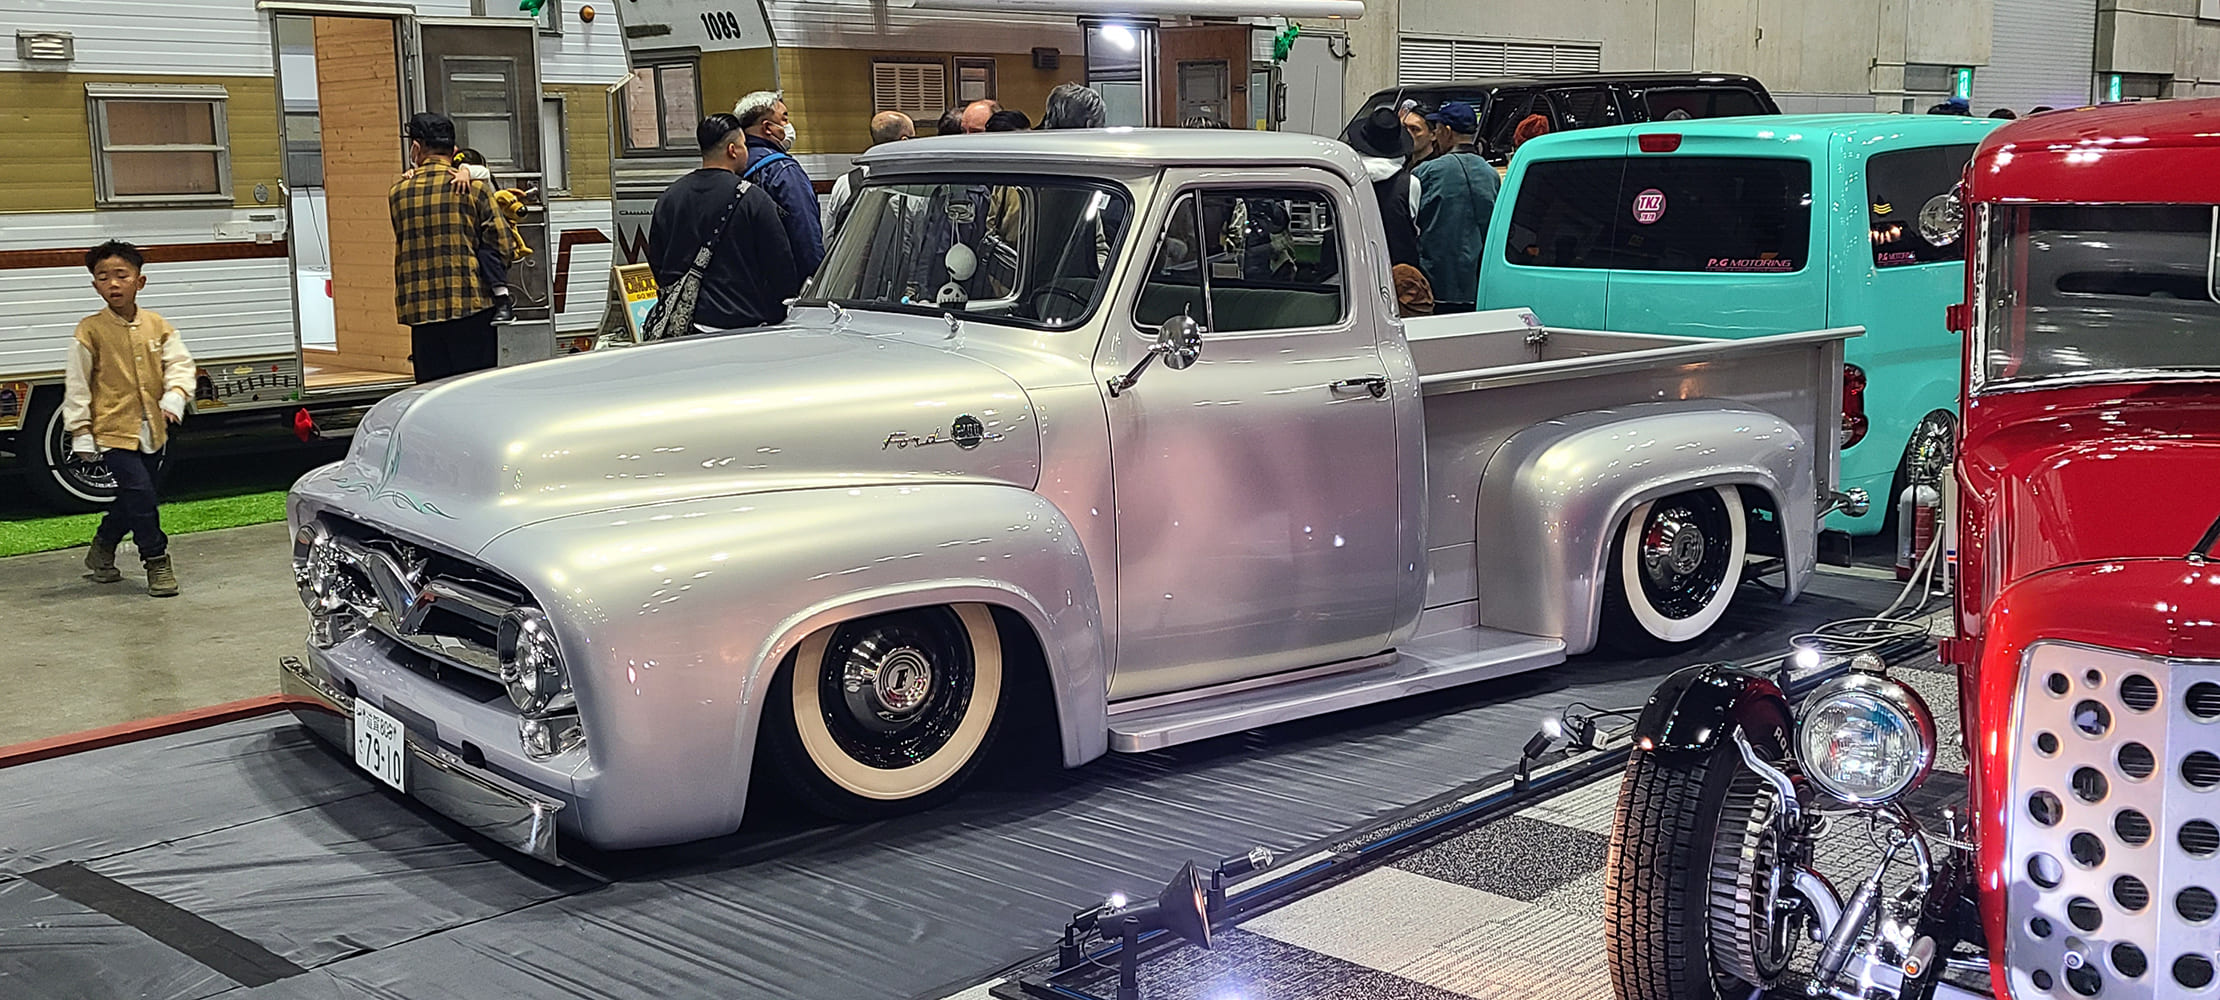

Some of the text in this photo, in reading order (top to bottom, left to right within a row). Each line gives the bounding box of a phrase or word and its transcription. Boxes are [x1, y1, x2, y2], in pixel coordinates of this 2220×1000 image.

[700, 11, 741, 40] 1089
[1639, 195, 1661, 210] TKZ
[1730, 259, 1792, 267] MOTORING
[881, 426, 941, 450] Ford
